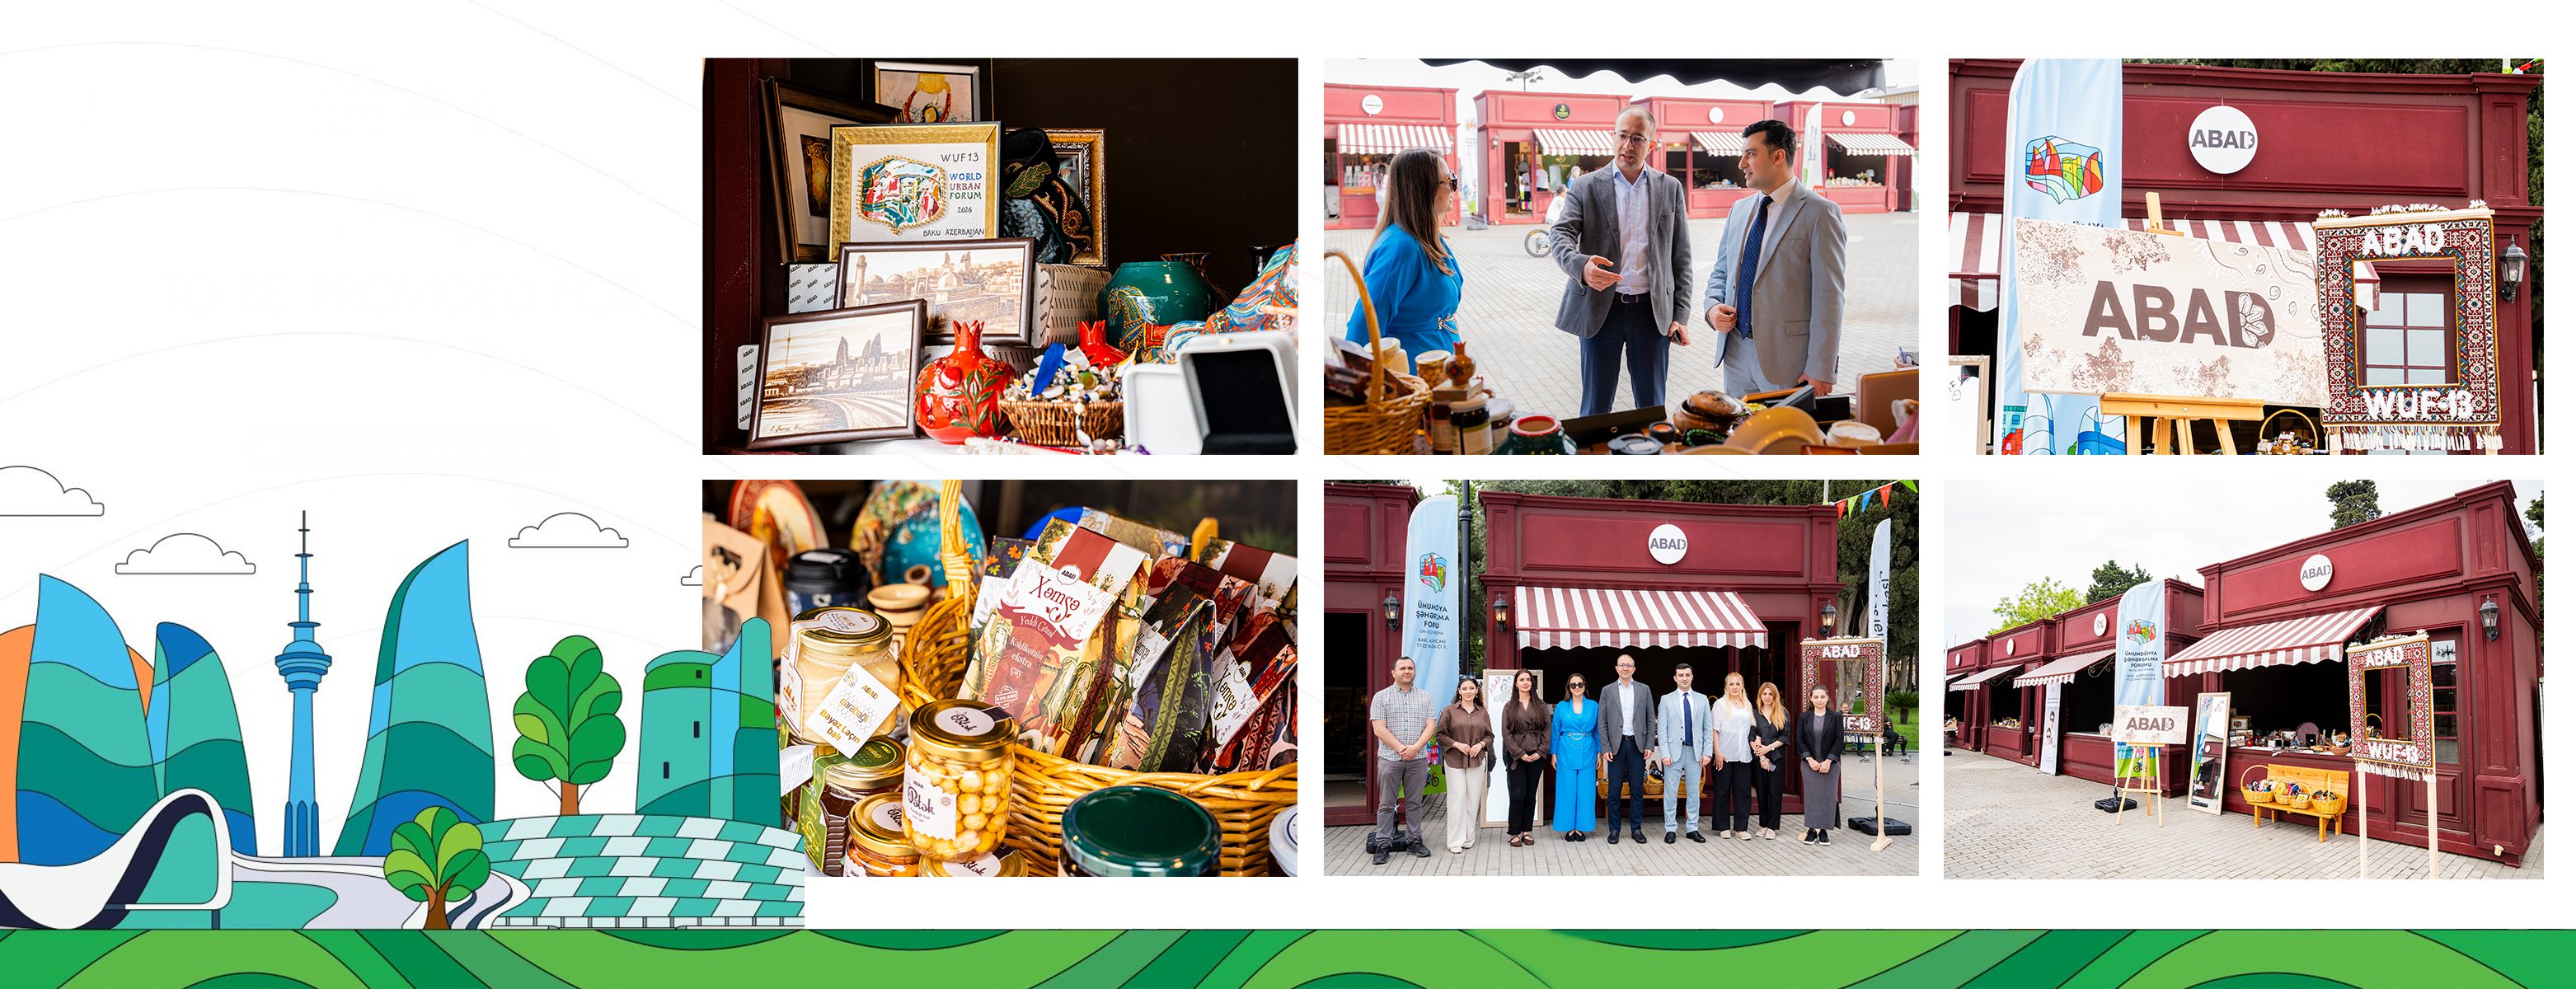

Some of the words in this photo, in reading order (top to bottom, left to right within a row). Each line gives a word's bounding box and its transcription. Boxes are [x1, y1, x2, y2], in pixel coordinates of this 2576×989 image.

[2191, 129, 2255, 149] ABAD
[949, 172, 982, 180] WORLD
[950, 182, 981, 190] URBAN
[949, 191, 982, 199] FORUM
[922, 229, 941, 237] BAKU
[2362, 223, 2445, 256] ABAD
[2081, 280, 2276, 349] ABAD
[1649, 537, 1687, 551] ABAD
[1061, 569, 1077, 580] ABAD
[2301, 565, 2331, 581] ABAD
[1029, 575, 1081, 623] Xəmşə
[1021, 615, 1039, 627] Yeddi
[1010, 636, 1044, 660] Kəklikotulu
[1822, 644, 1860, 658] ABAD
[1011, 651, 1032, 668] ekstra
[2366, 646, 2404, 667] ABAD
[1010, 666, 1024, 678] çay
[861, 685, 879, 700] ABAD
[1213, 668, 1237, 720] Xəmşə
[840, 697, 870, 724] qarabağlı
[819, 709, 842, 729] Bəyaz
[841, 726, 861, 743] Laçın
[1843, 716, 1872, 730] F-13
[2125, 717, 2175, 731] ABAD
[827, 727, 842, 741] balı
